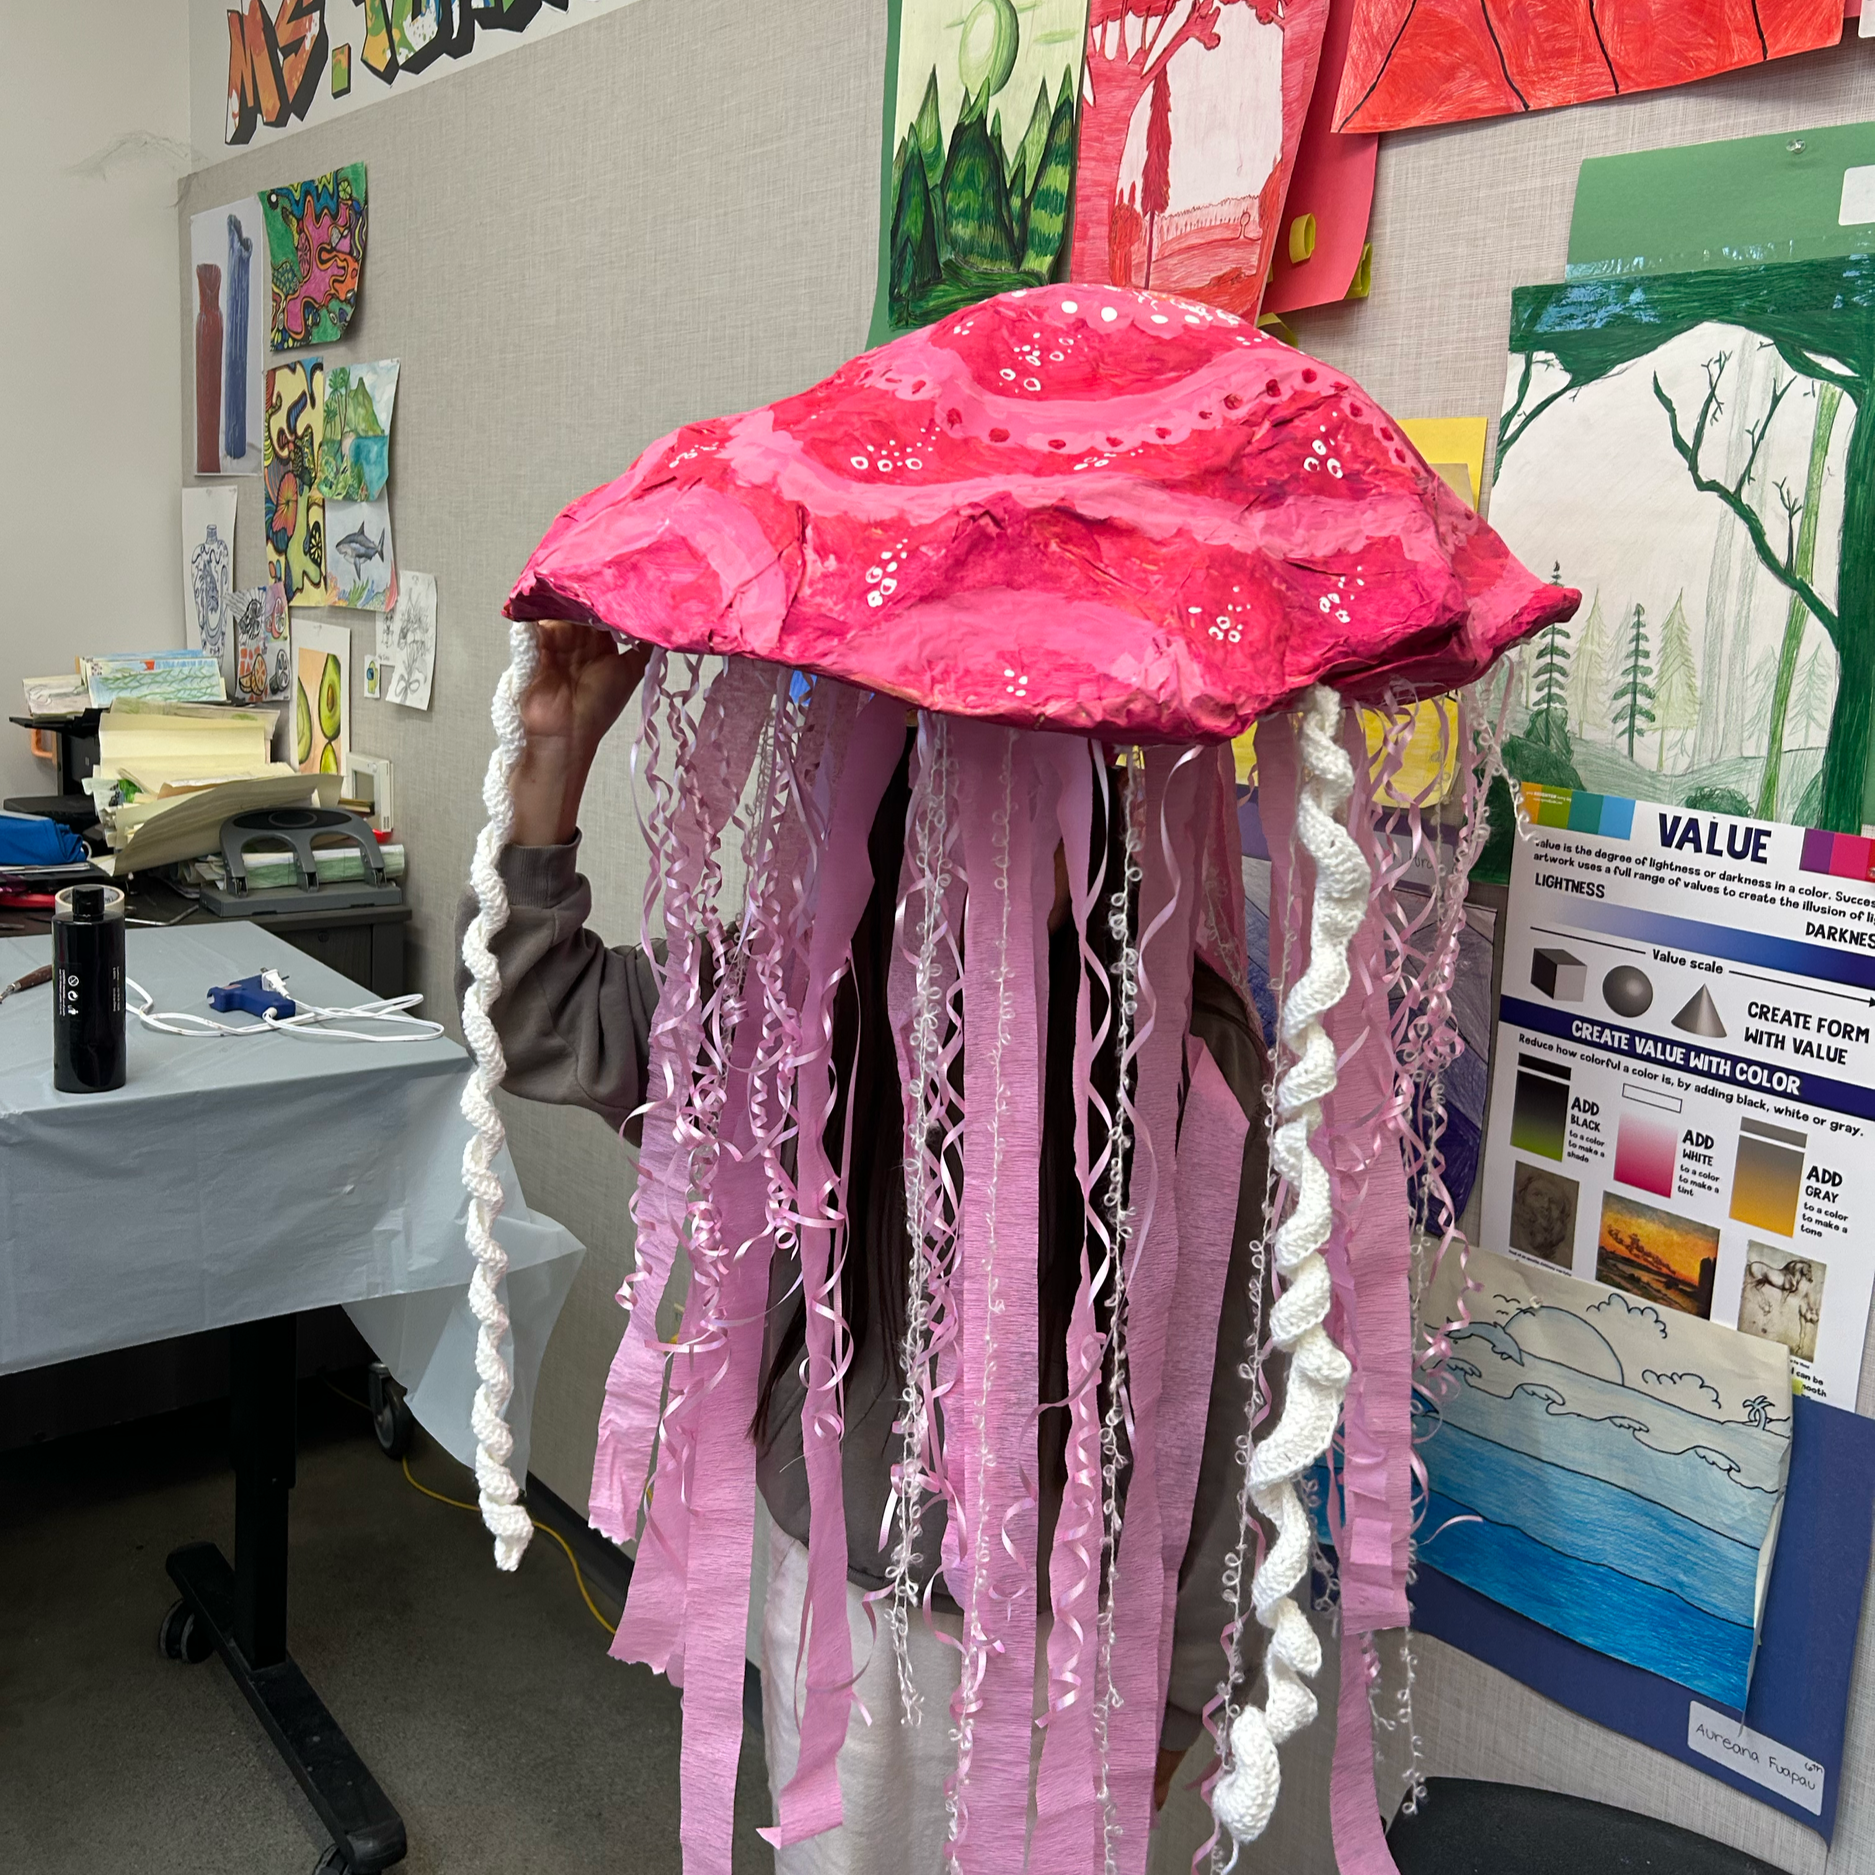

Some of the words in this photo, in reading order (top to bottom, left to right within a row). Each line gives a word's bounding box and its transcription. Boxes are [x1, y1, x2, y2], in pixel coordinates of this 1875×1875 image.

[1659, 812, 1772, 864] VALUE
[1563, 842, 1573, 853] is
[1575, 844, 1592, 856] the
[1594, 849, 1632, 864] degree
[1635, 856, 1648, 867] of
[1649, 857, 1700, 876] lightness
[1704, 869, 1716, 878] or
[1719, 870, 1772, 889] darkness
[1774, 881, 1786, 891] in
[1788, 884, 1795, 893] a
[1799, 886, 1832, 900] color.
[1533, 852, 1574, 867] artwork
[1578, 860, 1602, 872] uses
[1605, 866, 1611, 874] a
[1613, 866, 1632, 878] full
[1634, 872, 1665, 885] range
[1668, 877, 1681, 887] of
[1683, 880, 1720, 894] values
[1723, 886, 1736, 897] to
[1738, 890, 1776, 905] create
[1780, 896, 1799, 909] the
[1802, 900, 1846, 918] illusion
[1850, 911, 1865, 921] of
[1535, 872, 1605, 898] LIGHTNESS
[1653, 949, 1686, 966] Value
[1690, 960, 1723, 974] scale
[1748, 1001, 1812, 1030] CREATE
[1816, 1017, 1870, 1044] FORM
[1744, 1027, 1786, 1050] WITH
[1792, 1037, 1848, 1065] VALUE
[1572, 1020, 1630, 1049] CREATE
[1635, 1036, 1686, 1065] VALUE
[1689, 1051, 1731, 1077] WITH
[1735, 1063, 1801, 1095] COLOR
[1519, 1033, 1554, 1051] Reduce
[1556, 1044, 1577, 1058] how
[1580, 1053, 1620, 1071] colorful
[1623, 1065, 1629, 1073] a
[1632, 1068, 1659, 1081] color
[1661, 1074, 1674, 1087] is,
[1677, 1078, 1691, 1091] by
[1694, 1084, 1733, 1103] adding
[1736, 1094, 1770, 1112] black,
[1773, 1105, 1809, 1122] white
[1812, 1115, 1827, 1126] or
[1829, 1120, 1864, 1137] gray.
[1571, 1096, 1600, 1116] ADD
[1571, 1114, 1600, 1132] BLACK
[1569, 1140, 1577, 1148] to
[1578, 1145, 1598, 1156] make
[1570, 1130, 1578, 1138] to
[1586, 1137, 1605, 1147] color
[1682, 1129, 1714, 1150] ADD
[1567, 1151, 1589, 1163] shade
[1683, 1148, 1714, 1167] WHITE
[1679, 1174, 1688, 1184] to
[1690, 1180, 1712, 1191] make
[1680, 1164, 1690, 1173] to
[1698, 1172, 1720, 1182] color
[1806, 1165, 1843, 1187] ADD
[1678, 1185, 1694, 1197] tint
[1805, 1185, 1839, 1204] GRAY
[1804, 1202, 1814, 1211] to
[1824, 1210, 1849, 1221] color
[1801, 1224, 1823, 1238] tone
[1802, 1213, 1813, 1223] to
[1815, 1218, 1839, 1231] make
[1796, 1371, 1811, 1381] can
[1813, 1376, 1824, 1386] be
[1695, 1723, 1760, 1764] Aureana
